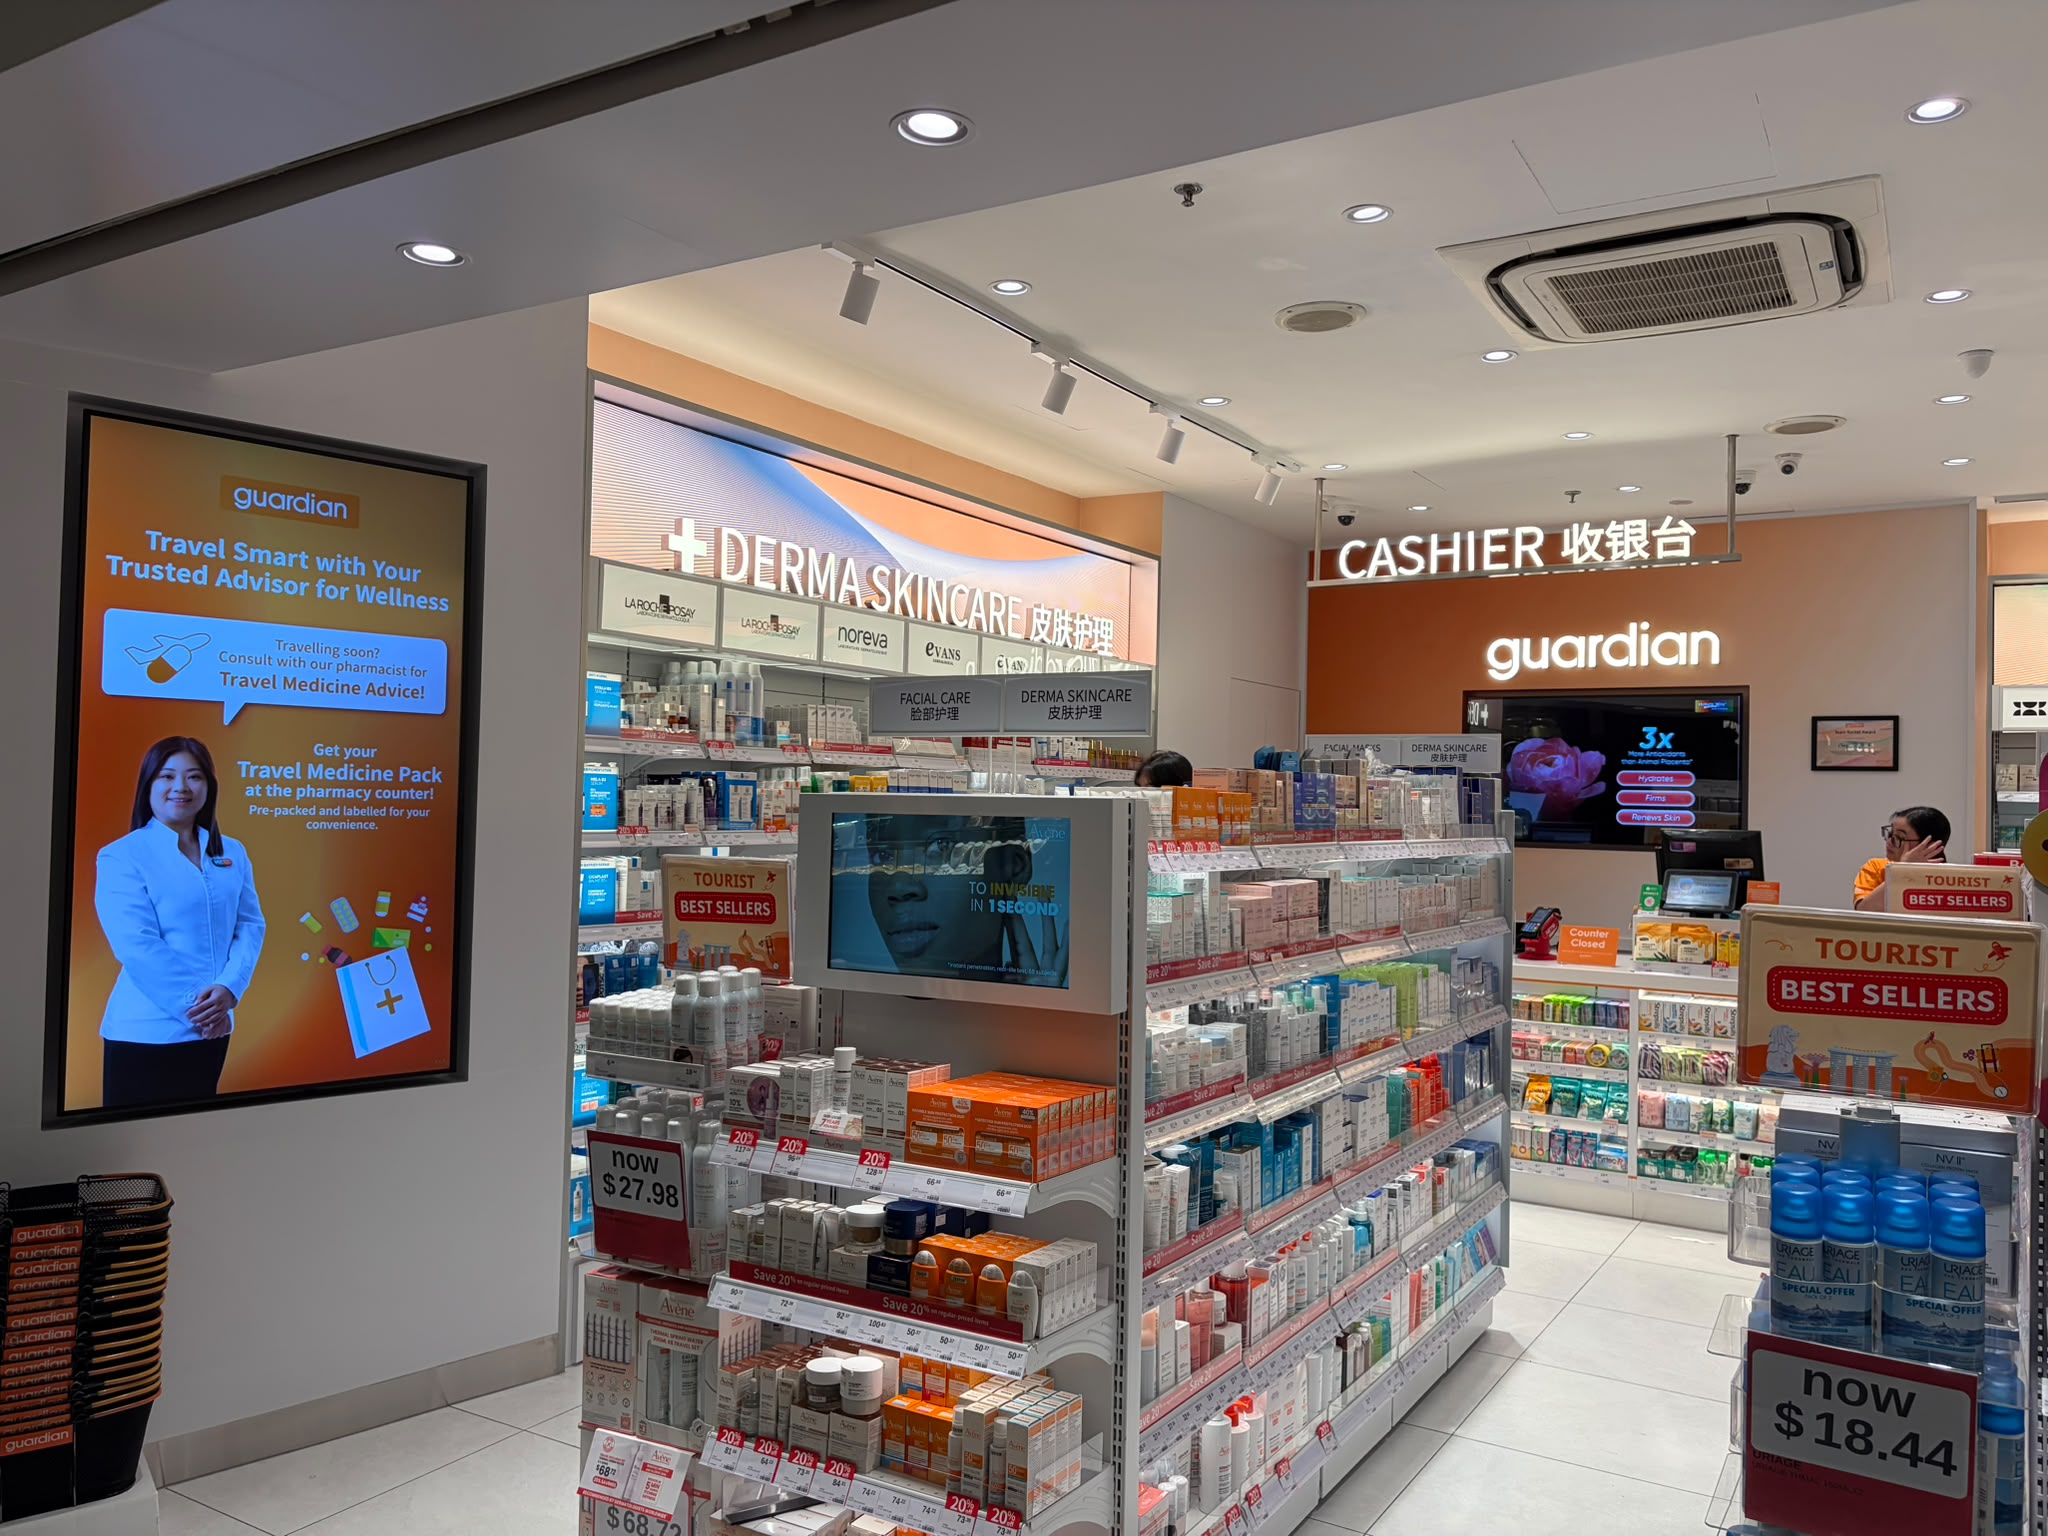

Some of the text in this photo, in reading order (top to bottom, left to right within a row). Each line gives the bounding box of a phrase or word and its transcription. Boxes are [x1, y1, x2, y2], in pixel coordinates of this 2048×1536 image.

[234, 487, 348, 520] guardian
[1337, 515, 1697, 580] CASHIER 收银台
[145, 530, 421, 583] Travel Smart with Your
[106, 555, 450, 612] Trusted Advisor for Wellness
[719, 526, 1114, 658] DERMA SKINCARE 皮肤护理
[624, 597, 696, 619] LA ROCHE POSAY
[741, 617, 800, 636] LA ROCHE POSAY
[838, 625, 888, 648] noreva
[275, 639, 380, 659] Travelling soon?
[1485, 620, 1721, 682] guardian
[219, 651, 428, 678] Consult with our pharmacist for
[219, 672, 425, 700] Travel Medicine Advice!
[900, 691, 971, 705] FACIAL CARE
[1021, 689, 1132, 703] DERMA SKINCARE
[910, 707, 960, 721] 脸部护理
[1047, 705, 1102, 721] 皮肤护理
[1639, 726, 1675, 749] 3x
[314, 744, 377, 760] Get your
[1411, 743, 1488, 753] DERMA SKINCARE
[1430, 753, 1468, 763] 皮肤护理
[237, 761, 442, 783] Travel Medicine Pack
[1638, 775, 1675, 784] Hydrates
[245, 784, 434, 802] at the pharmacy counter!
[1645, 794, 1667, 802] Firms
[249, 805, 430, 819] Pre-packed and labelled for your
[1631, 813, 1681, 822] Renews Skin
[306, 820, 378, 830] convenience.
[694, 872, 755, 889] TOURIST
[1926, 875, 1990, 888] TOURIST
[969, 881, 1055, 899] TO INVISIBLE
[680, 900, 771, 917] BEST SELLERS
[970, 899, 983, 912] IN
[1909, 894, 2008, 908] BEST SELLERS
[1569, 928, 1609, 939] Counter
[1570, 938, 1606, 949] Closed
[1815, 937, 1959, 969] TOURIST
[1781, 979, 1995, 1013] BEST SELLERS
[1194, 1088, 1206, 1101] Save
[782, 1138, 803, 1152] 20%
[612, 1150, 659, 1174] now
[862, 1151, 887, 1166] 20%
[1936, 1153, 1953, 1165] NV
[602, 1172, 679, 1208] $27.98
[17, 1225, 80, 1243] guardian
[1191, 1232, 1204, 1246] Save
[1776, 1242, 1814, 1257] URIAGE
[754, 1269, 776, 1284] Save
[779, 1274, 796, 1286] 20%
[1776, 1261, 1815, 1281] EAU
[1944, 1263, 1984, 1277] URIAGE
[1782, 1282, 1855, 1296] SPECIAL OFFER
[1901, 1275, 1928, 1294] EA
[1944, 1281, 1983, 1301] EAU
[660, 1296, 695, 1318] Avène
[882, 1296, 908, 1313] Save
[911, 1303, 929, 1316] 20%
[1905, 1299, 1981, 1315] SPECIAL OFFER
[9, 1329, 72, 1346] guardian
[1190, 1376, 1203, 1391] Save
[1803, 1367, 1917, 1419] now
[5, 1430, 69, 1452] guardian
[720, 1429, 741, 1445] 20%
[1773, 1399, 1958, 1477] $18.44
[758, 1439, 779, 1455] 20%
[791, 1450, 814, 1466] 20%
[829, 1460, 852, 1476] 20%
[950, 1496, 975, 1512] 20%
[992, 1508, 1016, 1524] 20%
